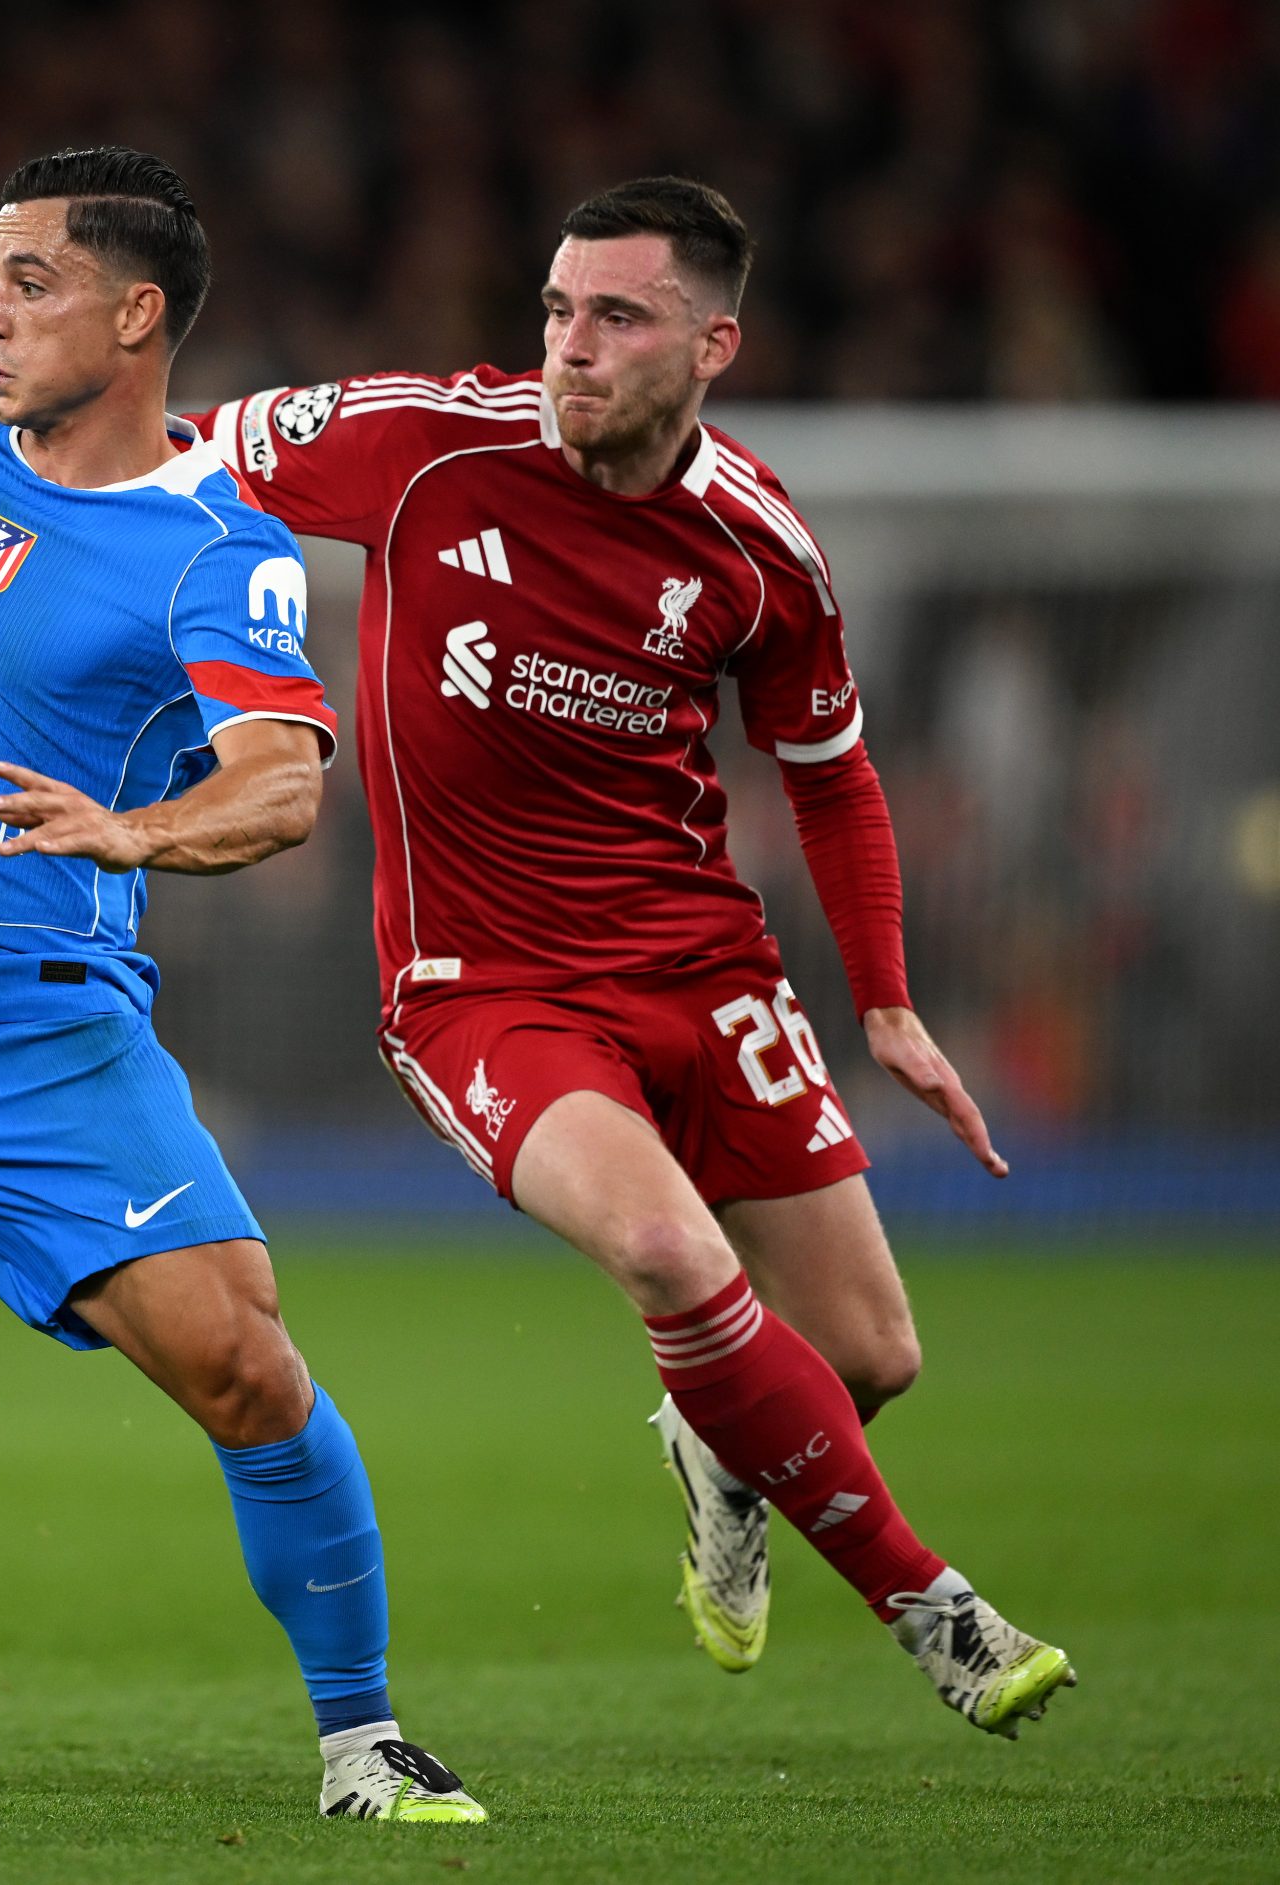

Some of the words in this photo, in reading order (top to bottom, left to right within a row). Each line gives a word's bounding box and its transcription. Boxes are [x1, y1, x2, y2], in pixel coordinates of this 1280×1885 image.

[248, 627, 310, 666] krak
[510, 652, 672, 708] standard
[812, 679, 854, 715] Exp
[505, 682, 667, 735] chartered
[711, 978, 827, 1107] 26
[760, 1431, 831, 1485] LFC
